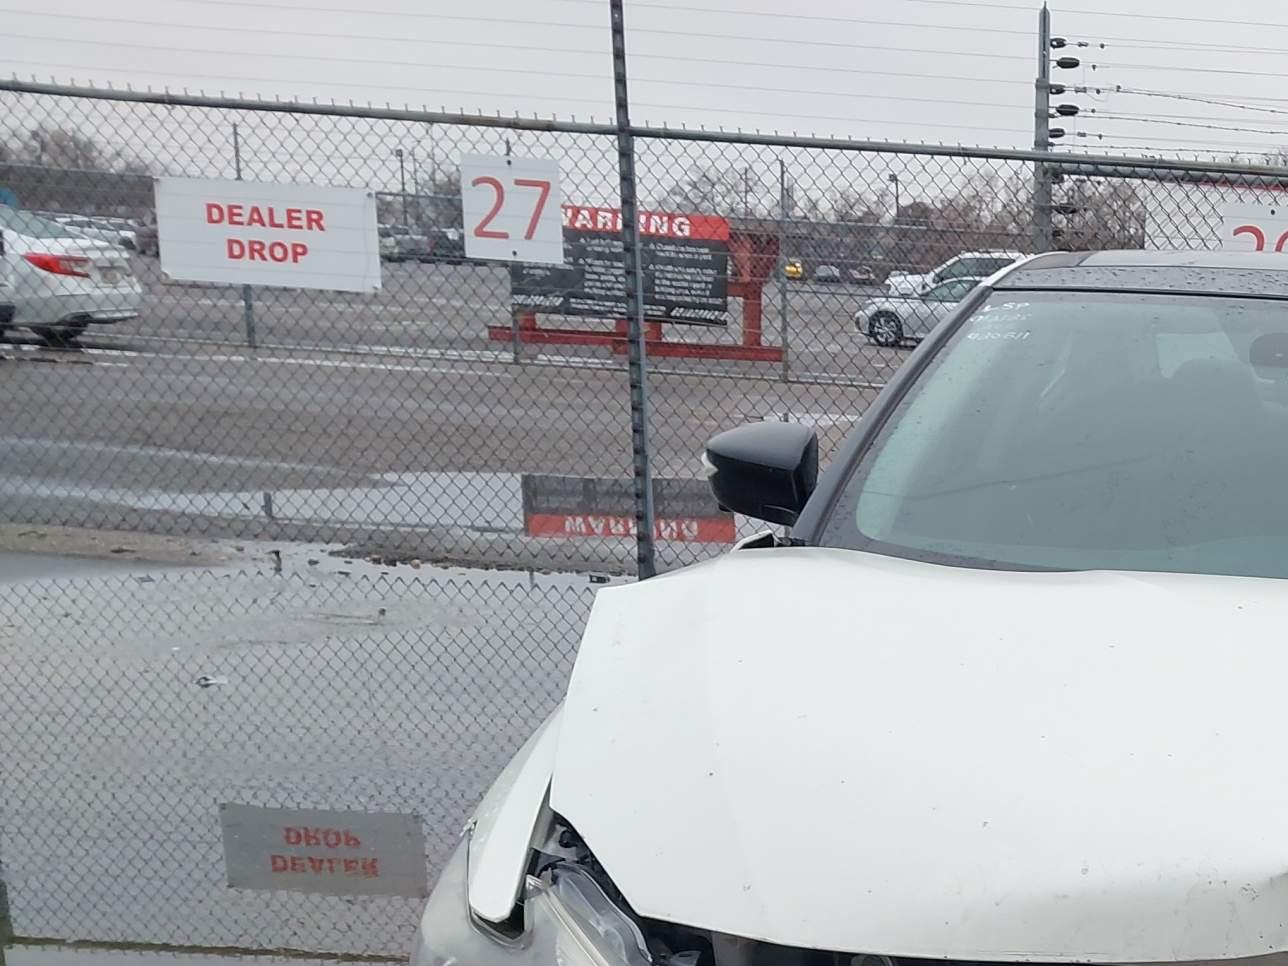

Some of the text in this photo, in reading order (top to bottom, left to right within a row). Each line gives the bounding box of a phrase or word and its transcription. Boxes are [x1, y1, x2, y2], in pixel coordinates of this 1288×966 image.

[205, 203, 326, 231] DEALER
[473, 175, 551, 240] 27
[226, 238, 309, 264] DROP
